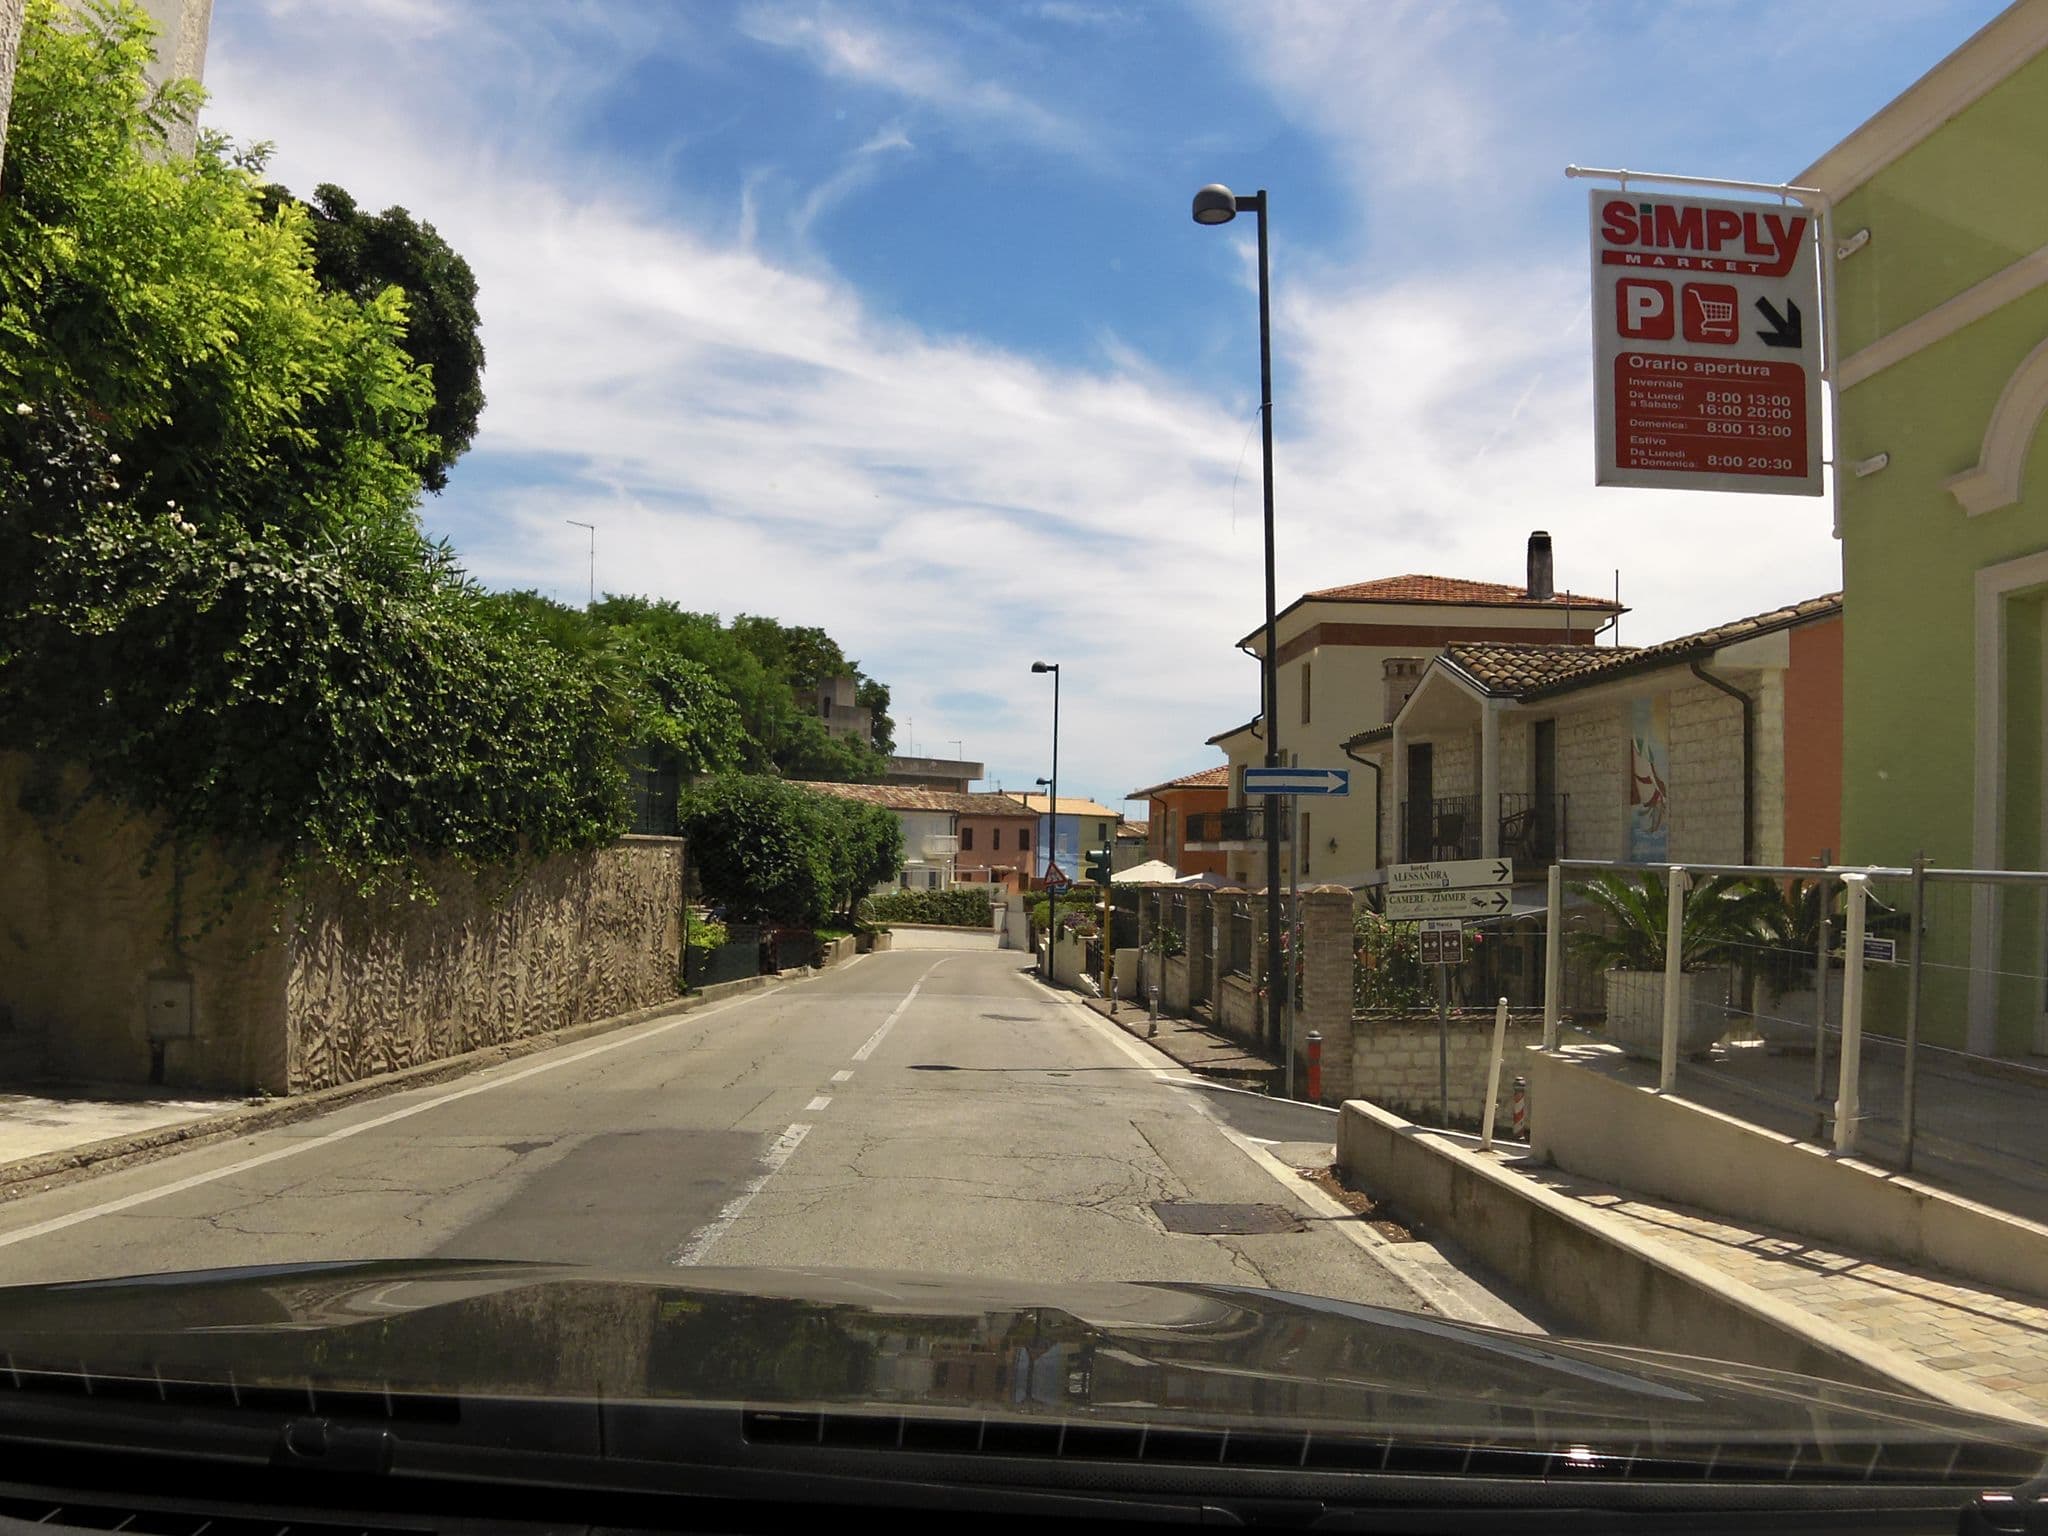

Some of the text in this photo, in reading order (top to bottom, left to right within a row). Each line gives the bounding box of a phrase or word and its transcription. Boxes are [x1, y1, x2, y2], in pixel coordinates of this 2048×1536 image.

[1625, 254, 1760, 273] MARKET
[1626, 286, 1664, 330] P
[1629, 355, 1770, 377] Orario apertura
[1629, 378, 1683, 389] Invernale
[1629, 390, 1644, 399] Da
[1706, 391, 1791, 407] 8:00 13:00
[1697, 403, 1791, 420] 16:00 20:00
[1707, 421, 1792, 438] 8:00 13:00
[1630, 435, 1667, 446] Estivo
[1630, 447, 1646, 457] Da
[1707, 454, 1793, 470] 8:00 20:30
[1394, 870, 1448, 882] ALESSANDRA
[1389, 894, 1424, 905] CAMERE
[1431, 892, 1467, 903] ZIMMER
